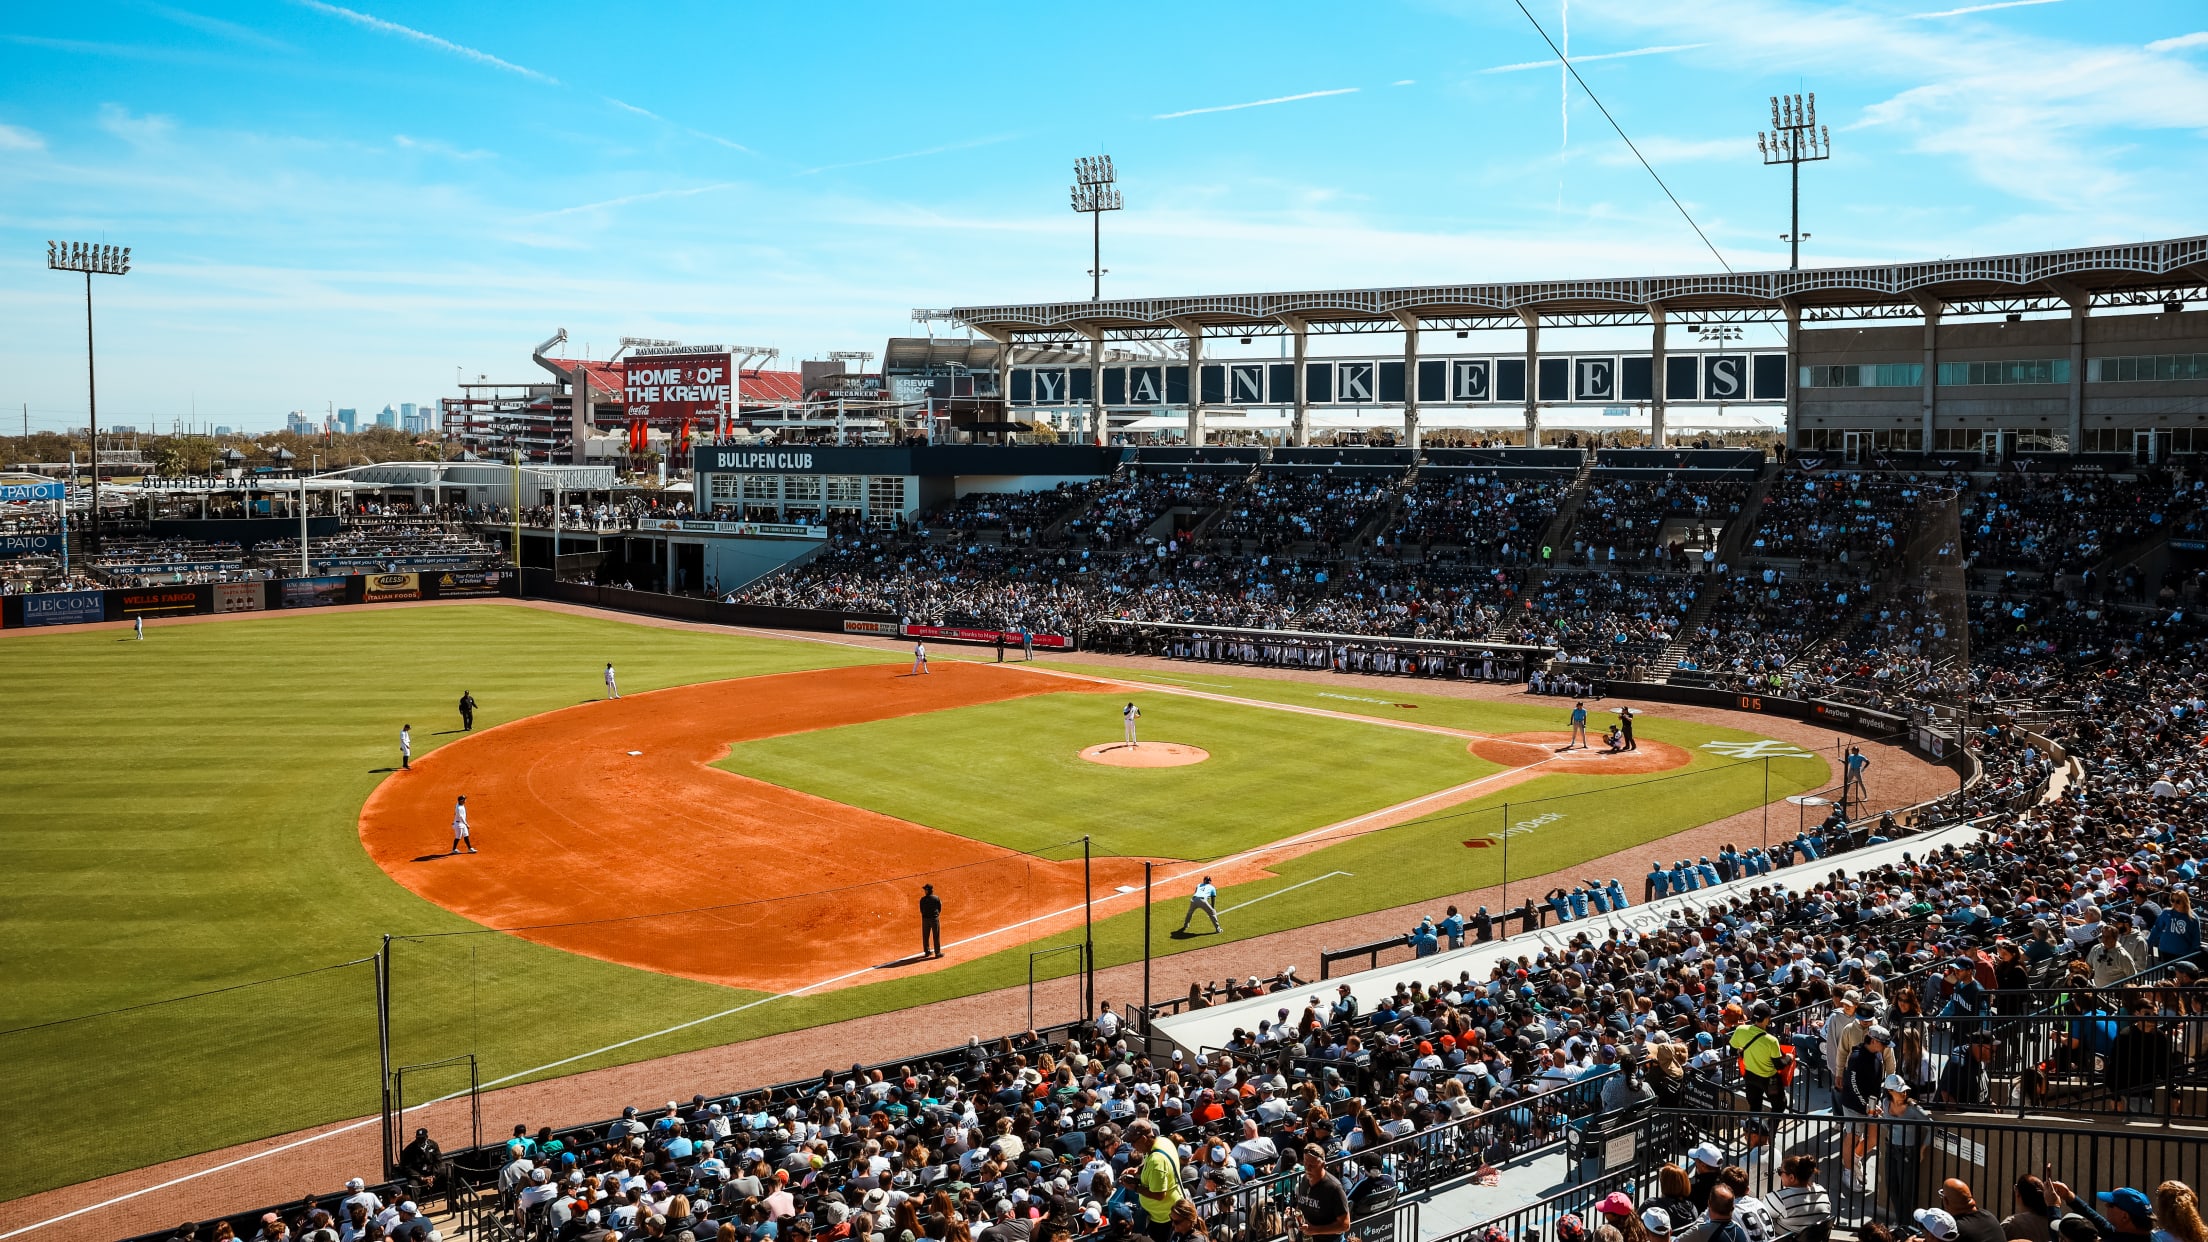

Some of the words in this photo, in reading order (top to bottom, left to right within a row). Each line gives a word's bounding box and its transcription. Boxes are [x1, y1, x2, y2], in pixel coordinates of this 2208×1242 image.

[635, 347, 669, 356] RAYMOND
[669, 346, 692, 355] JAMES
[693, 344, 723, 353] STADIUM
[627, 368, 681, 386] HOME
[697, 367, 723, 384] OF
[895, 379, 935, 387] KREWE
[625, 386, 660, 403] THE
[663, 385, 730, 402] KREWE
[717, 452, 776, 469] BULLPEN
[778, 453, 813, 469] CLUB
[142, 477, 217, 489] OUTFIELD
[226, 477, 259, 489] BAR
[7, 486, 48, 498] PATIO
[7, 536, 48, 549] PATIO
[500, 571, 513, 579] 314
[27, 597, 99, 612] LECOM
[123, 594, 159, 605] WELLS
[162, 592, 196, 603] FARGO
[845, 621, 879, 632] HOOTERS
[983, 632, 997, 640] Mage
[1824, 708, 1850, 718] AnyDesk
[1859, 716, 1897, 733] anydesk.com
[1488, 811, 1567, 840] AnyDesk
[1076, 1112, 1094, 1121] JUDGE
[1371, 1222, 1393, 1235] BayCare
